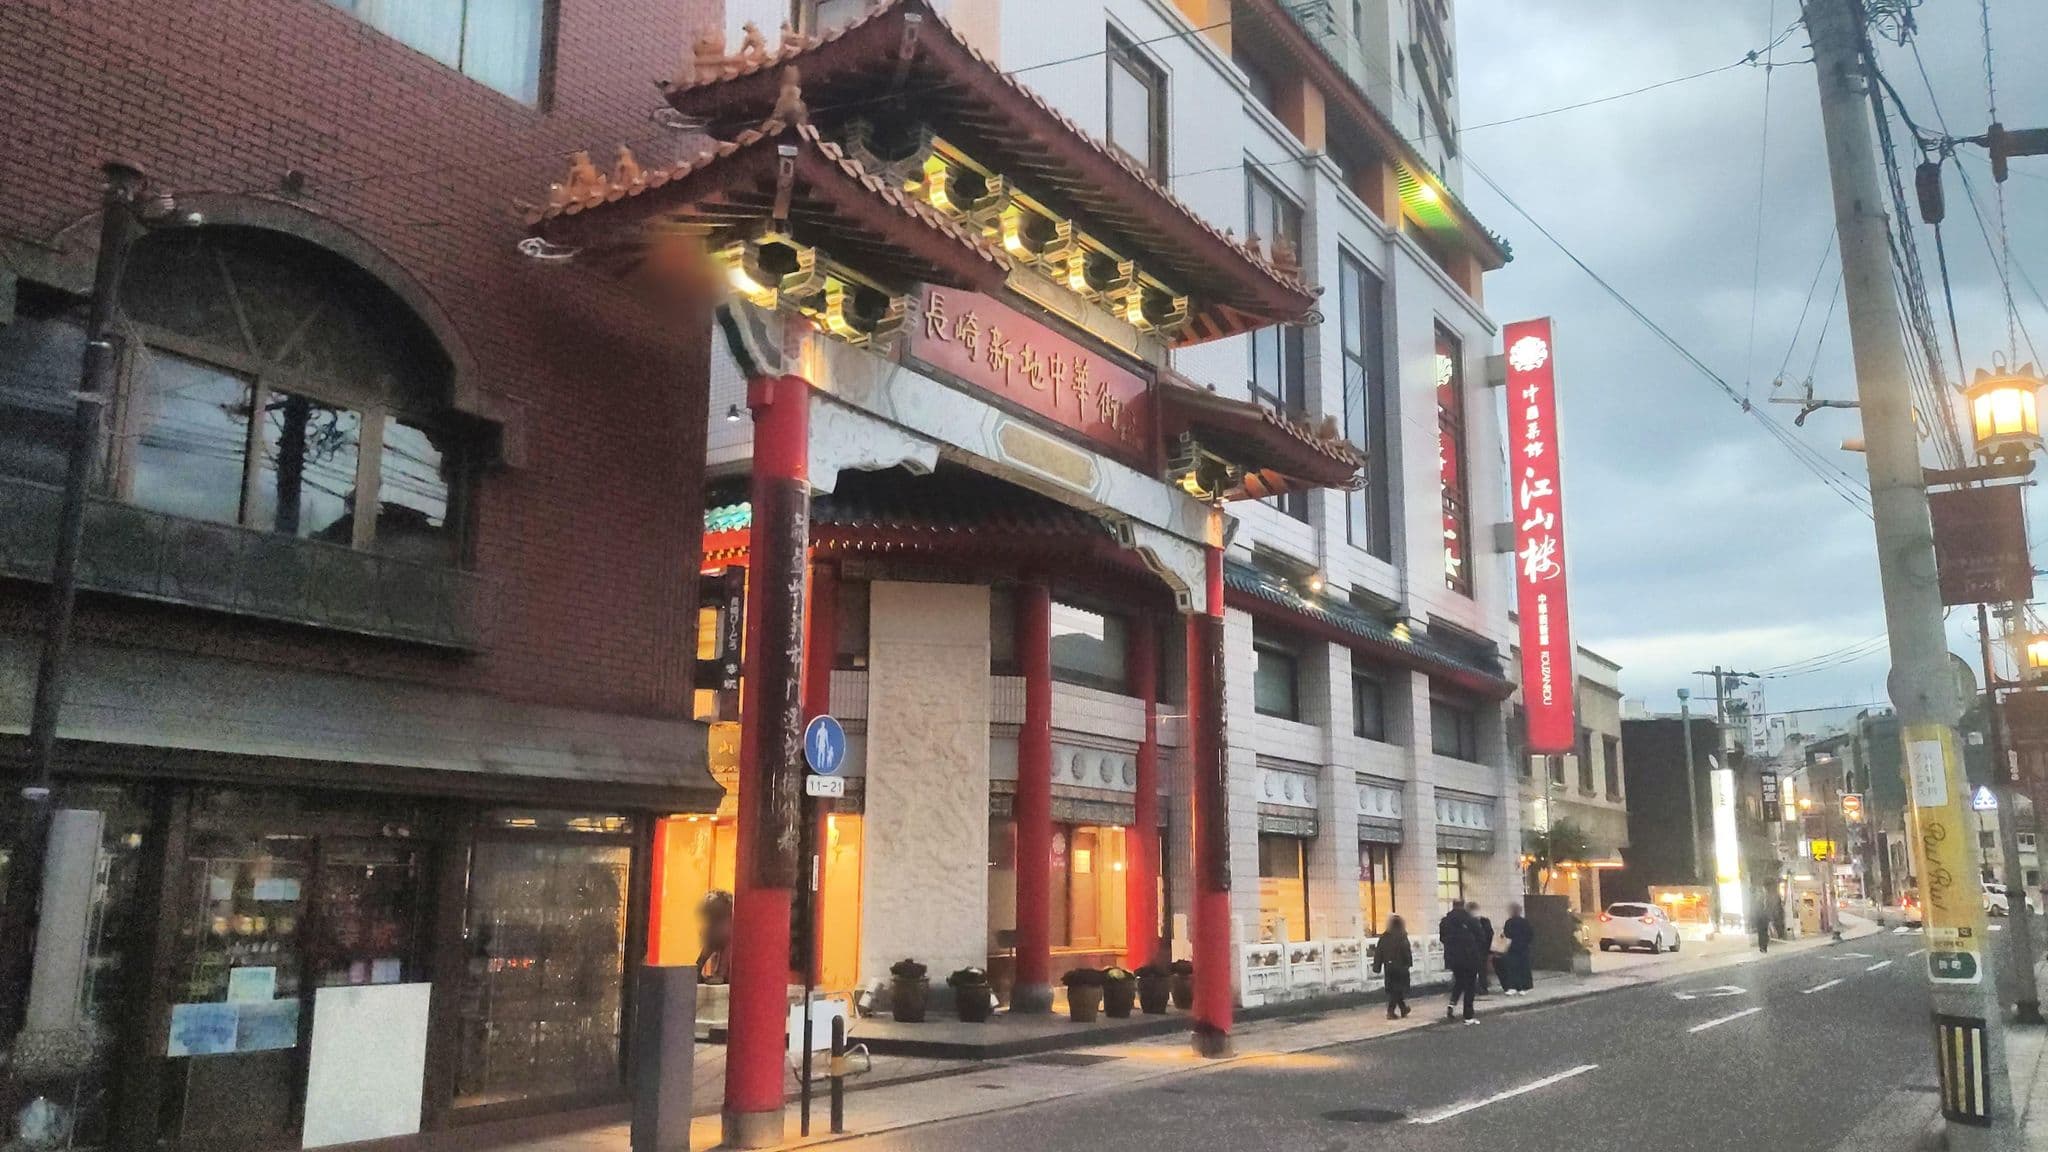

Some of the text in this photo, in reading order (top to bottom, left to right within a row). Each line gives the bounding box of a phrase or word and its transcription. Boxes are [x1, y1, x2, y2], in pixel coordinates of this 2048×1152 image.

[924, 291, 1122, 430] 長崎新地中華街
[1519, 467, 1561, 584] 江山楼
